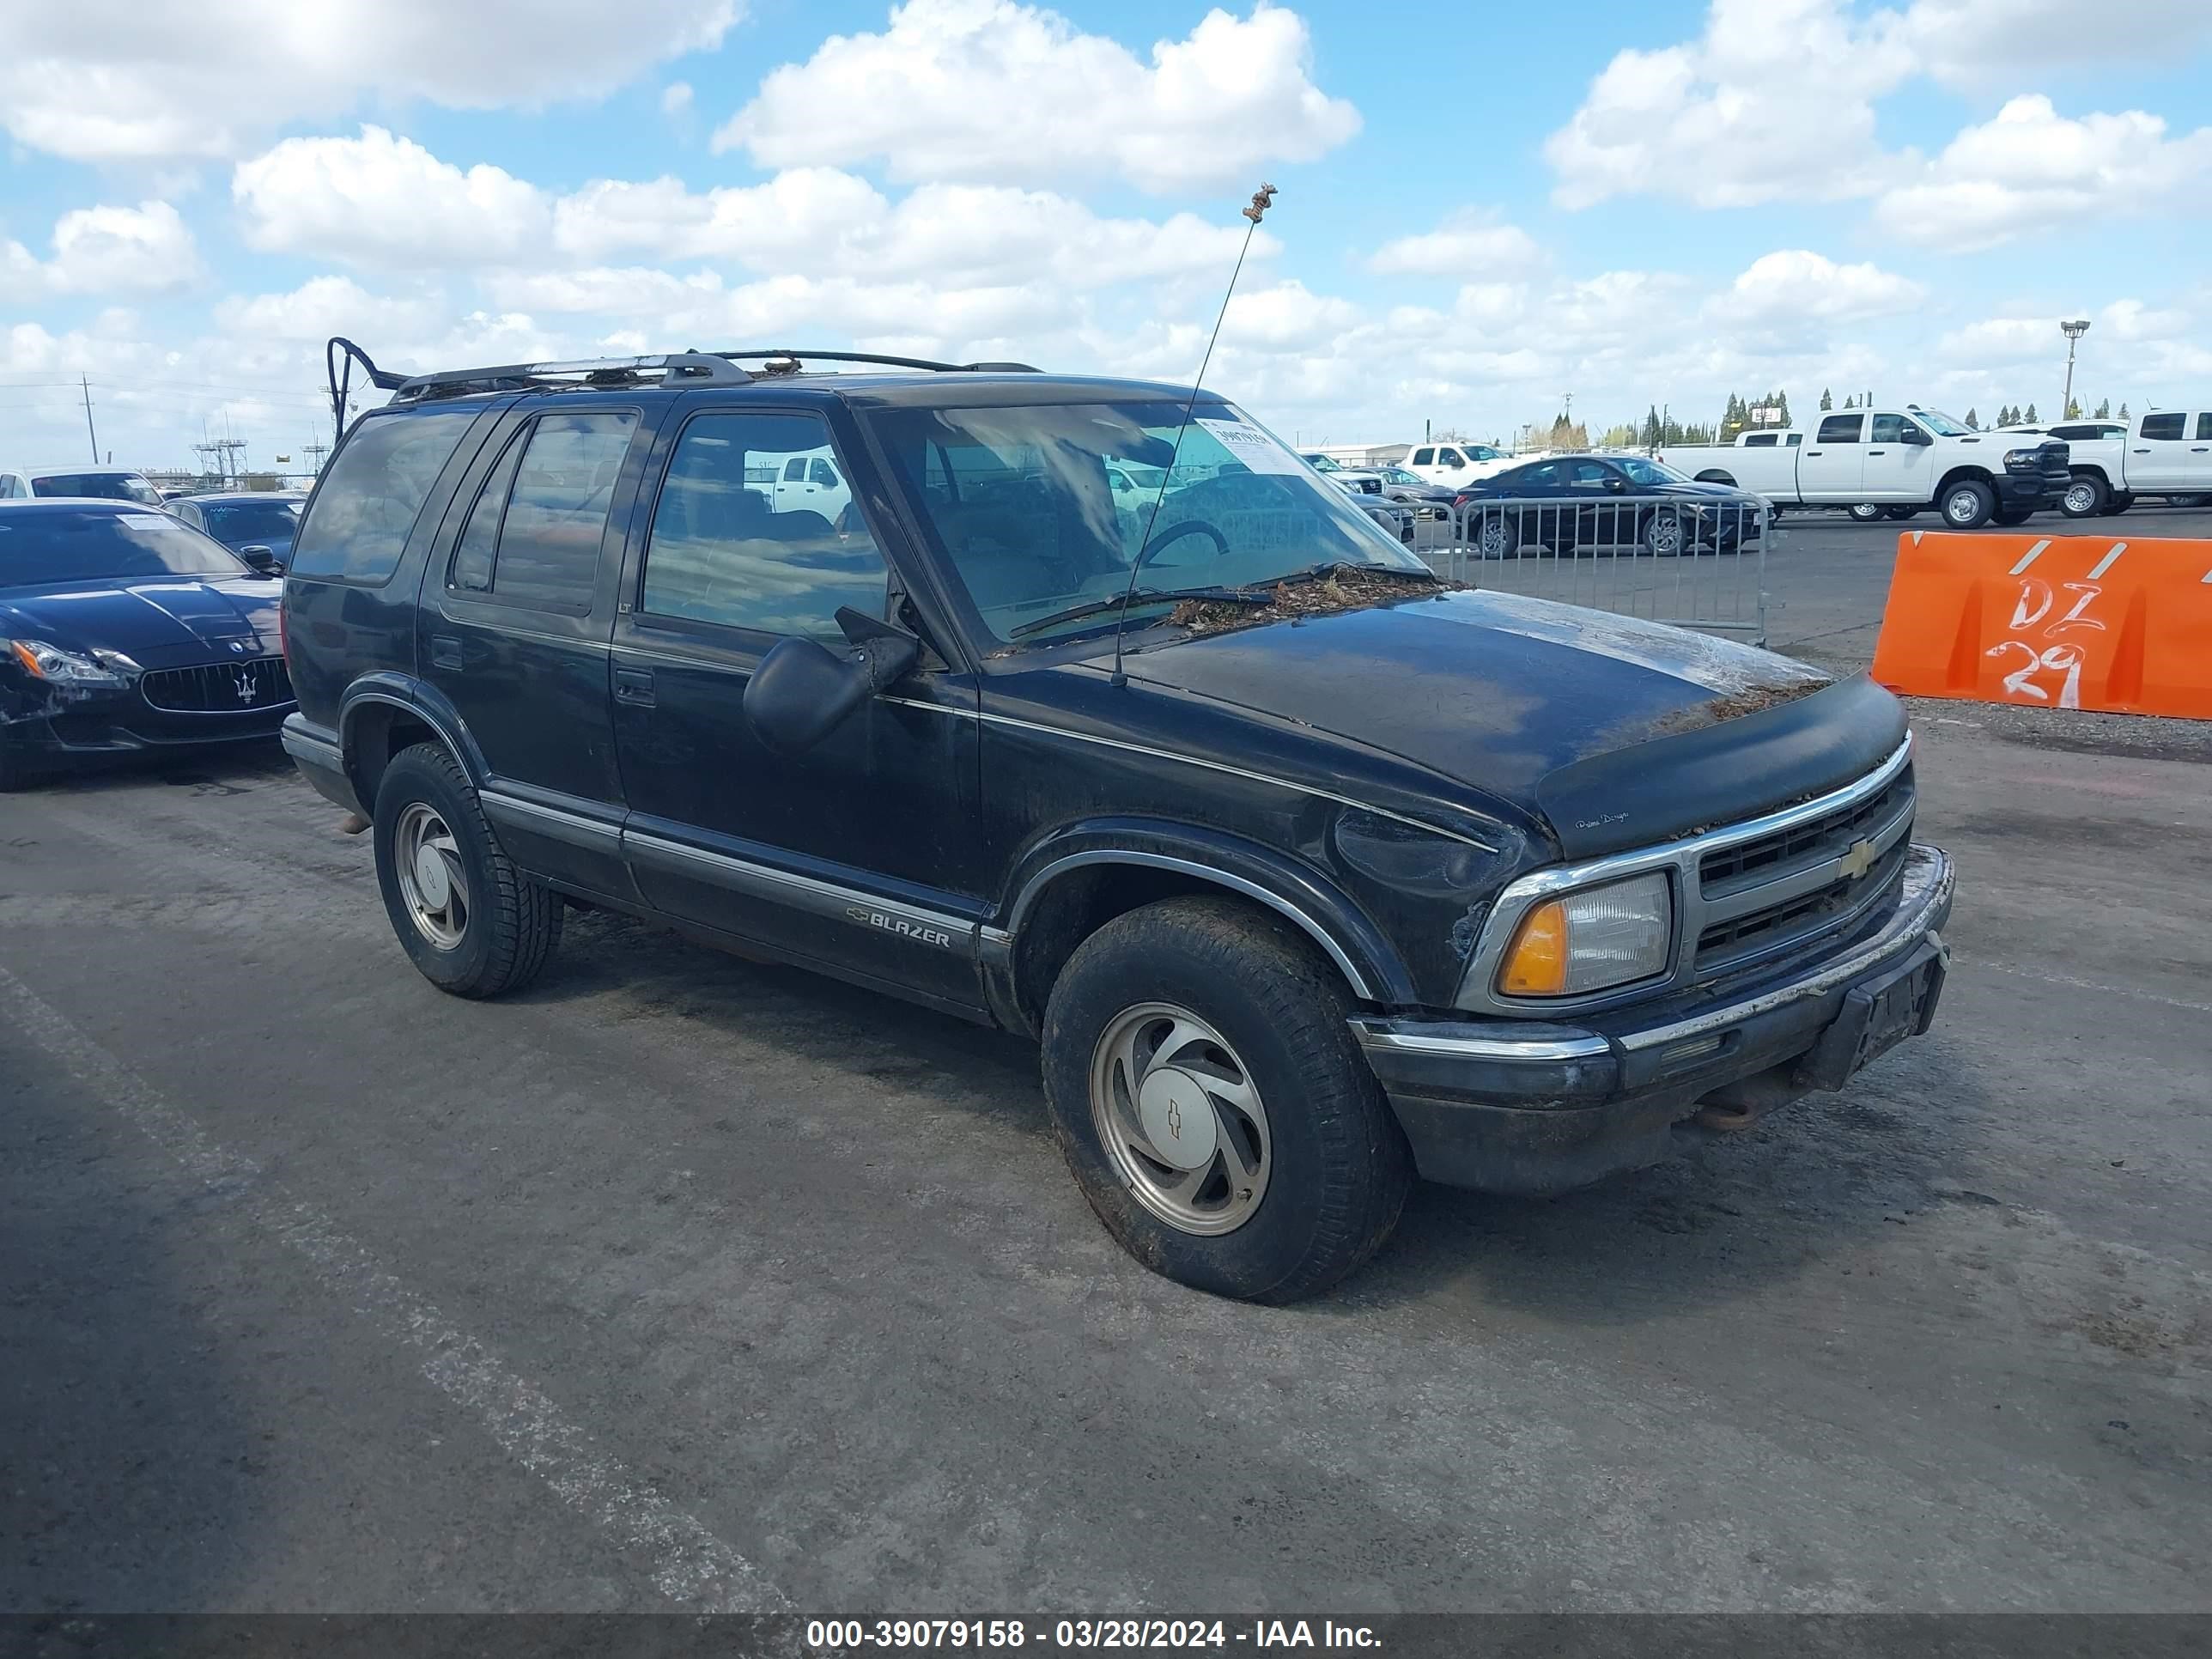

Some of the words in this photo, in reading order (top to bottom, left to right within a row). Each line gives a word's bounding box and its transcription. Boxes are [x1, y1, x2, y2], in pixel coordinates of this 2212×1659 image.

[619, 603, 631, 613] LT
[1985, 641, 2086, 708] 29
[871, 913, 950, 947] BLAZER
